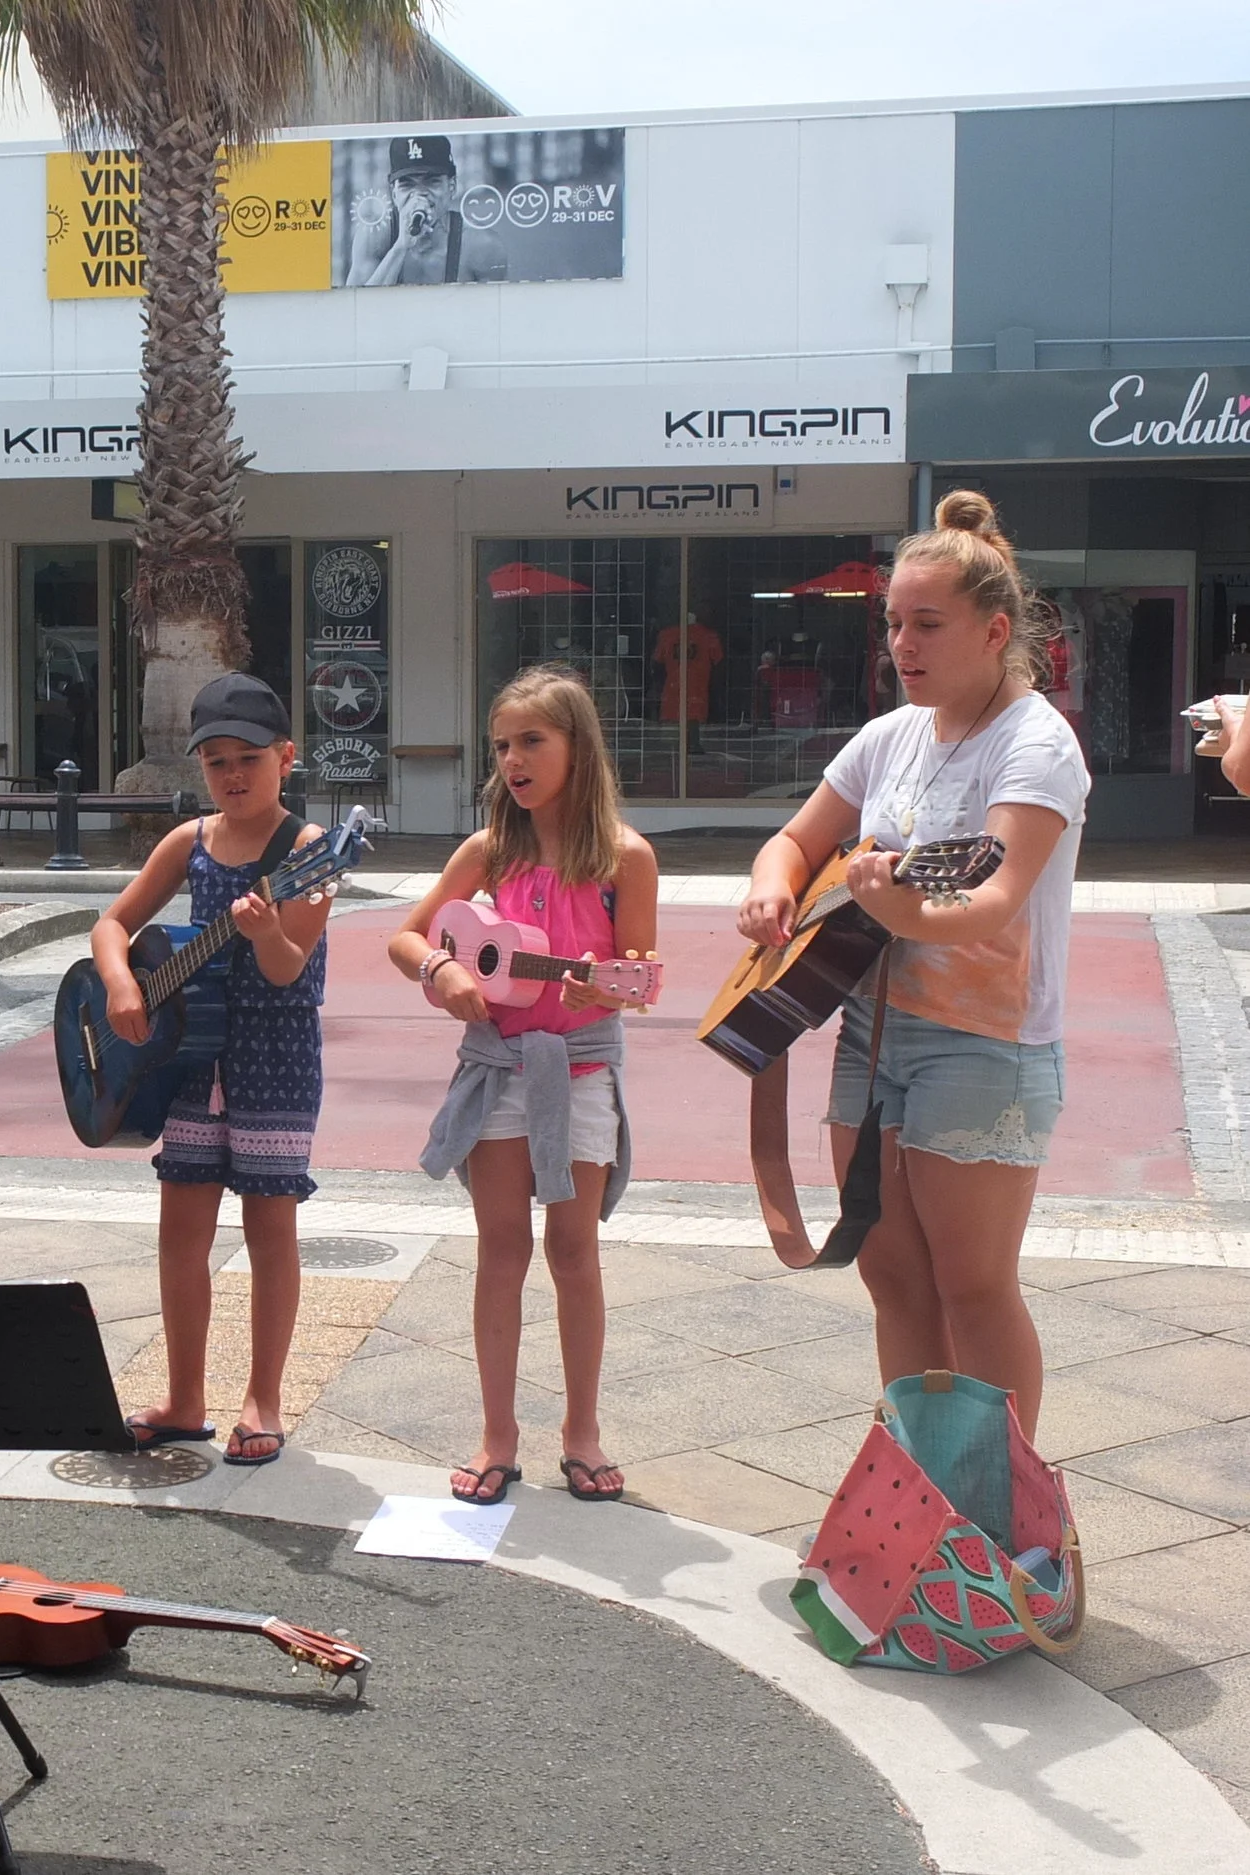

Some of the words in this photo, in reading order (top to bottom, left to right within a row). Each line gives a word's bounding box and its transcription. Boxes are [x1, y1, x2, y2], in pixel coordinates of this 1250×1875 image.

[81, 168, 141, 196] VIN
[81, 199, 141, 227] VIN
[552, 212, 588, 223] 29-31
[589, 210, 615, 222] DEC
[274, 223, 303, 232] 29-31
[304, 221, 326, 231] DEC
[665, 407, 891, 439] KINGPIN
[665, 440, 759, 449] EASTCOAST
[771, 439, 803, 447] NEW
[816, 438, 892, 446] ZEALAND
[4, 456, 90, 464] EASTCOAST
[566, 483, 760, 511] KINGPIN
[696, 510, 760, 518] ZEALAND
[340, 550, 364, 560] EAST
[364, 559, 379, 589] COAST
[321, 625, 372, 640] GIZZI
[312, 737, 382, 763] GISBORNE
[320, 761, 372, 778] Raised
